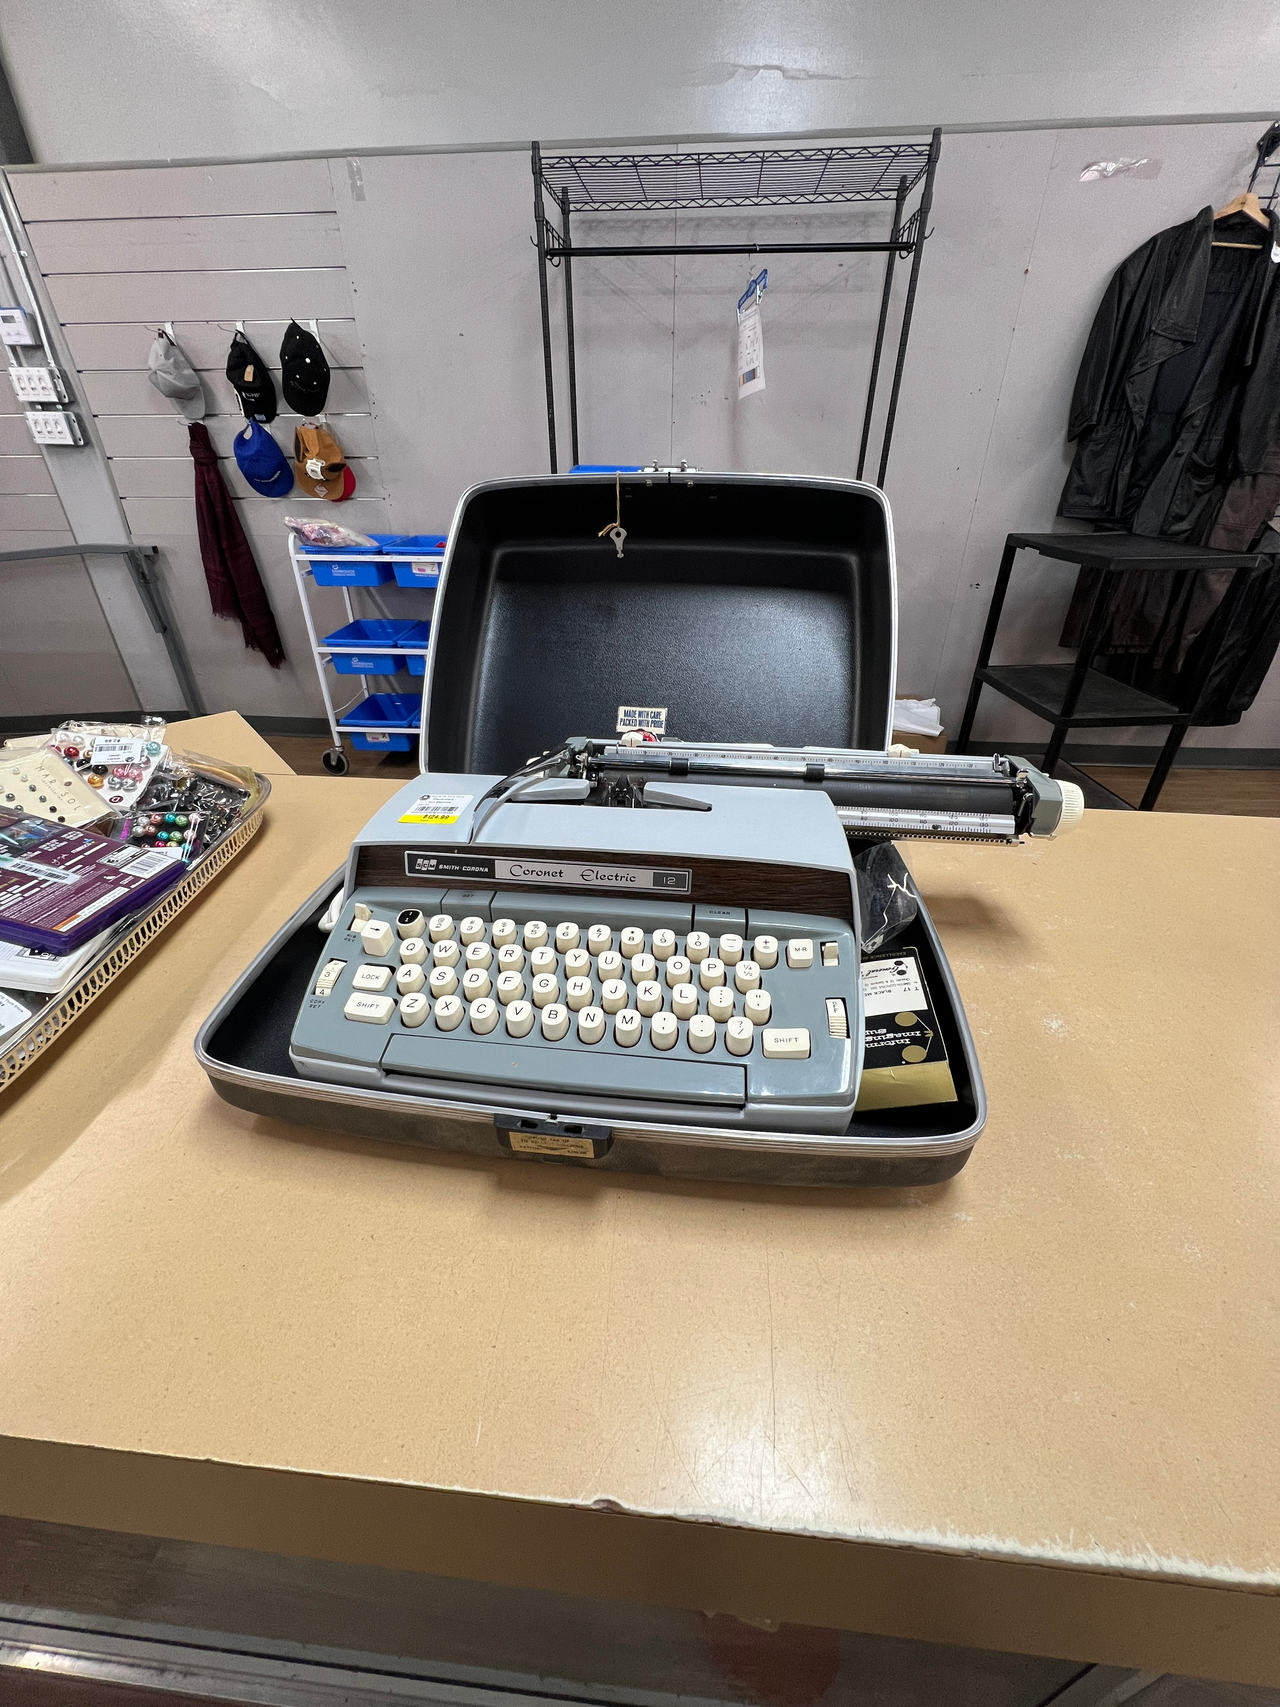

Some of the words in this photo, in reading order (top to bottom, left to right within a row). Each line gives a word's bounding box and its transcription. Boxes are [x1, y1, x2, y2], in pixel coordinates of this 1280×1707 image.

[623, 709, 637, 718] MADE
[637, 710, 650, 719] WITH
[650, 711, 662, 719] CARE
[620, 718, 637, 727] PACKED
[637, 719, 650, 727] WITH
[650, 719, 664, 729] PRIDE
[509, 864, 564, 878] Coronet
[580, 868, 637, 883] Electric
[663, 876, 676, 885] 12
[405, 942, 416, 952] Q
[438, 944, 452, 953] W
[471, 946, 483, 956] E
[503, 949, 515, 958] R
[539, 951, 547, 960] T
[573, 953, 581, 962] Y
[604, 956, 614, 965] U
[707, 963, 717, 972] P
[361, 973, 381, 981] LOCK
[402, 969, 412, 978] A
[436, 971, 447, 981] S
[468, 973, 480, 983] D
[502, 976, 514, 985] F
[539, 978, 550, 988] G
[572, 981, 584, 991] H
[609, 985, 618, 994] J
[643, 986, 654, 996] K
[679, 989, 689, 999] L
[355, 1001, 380, 1009] SHIFT
[406, 998, 419, 1008] Z
[441, 1001, 453, 1011] X
[476, 1004, 487, 1014] C
[514, 1006, 524, 1016] V
[547, 1009, 559, 1020] B
[584, 1012, 596, 1023] N
[621, 1015, 634, 1025] M
